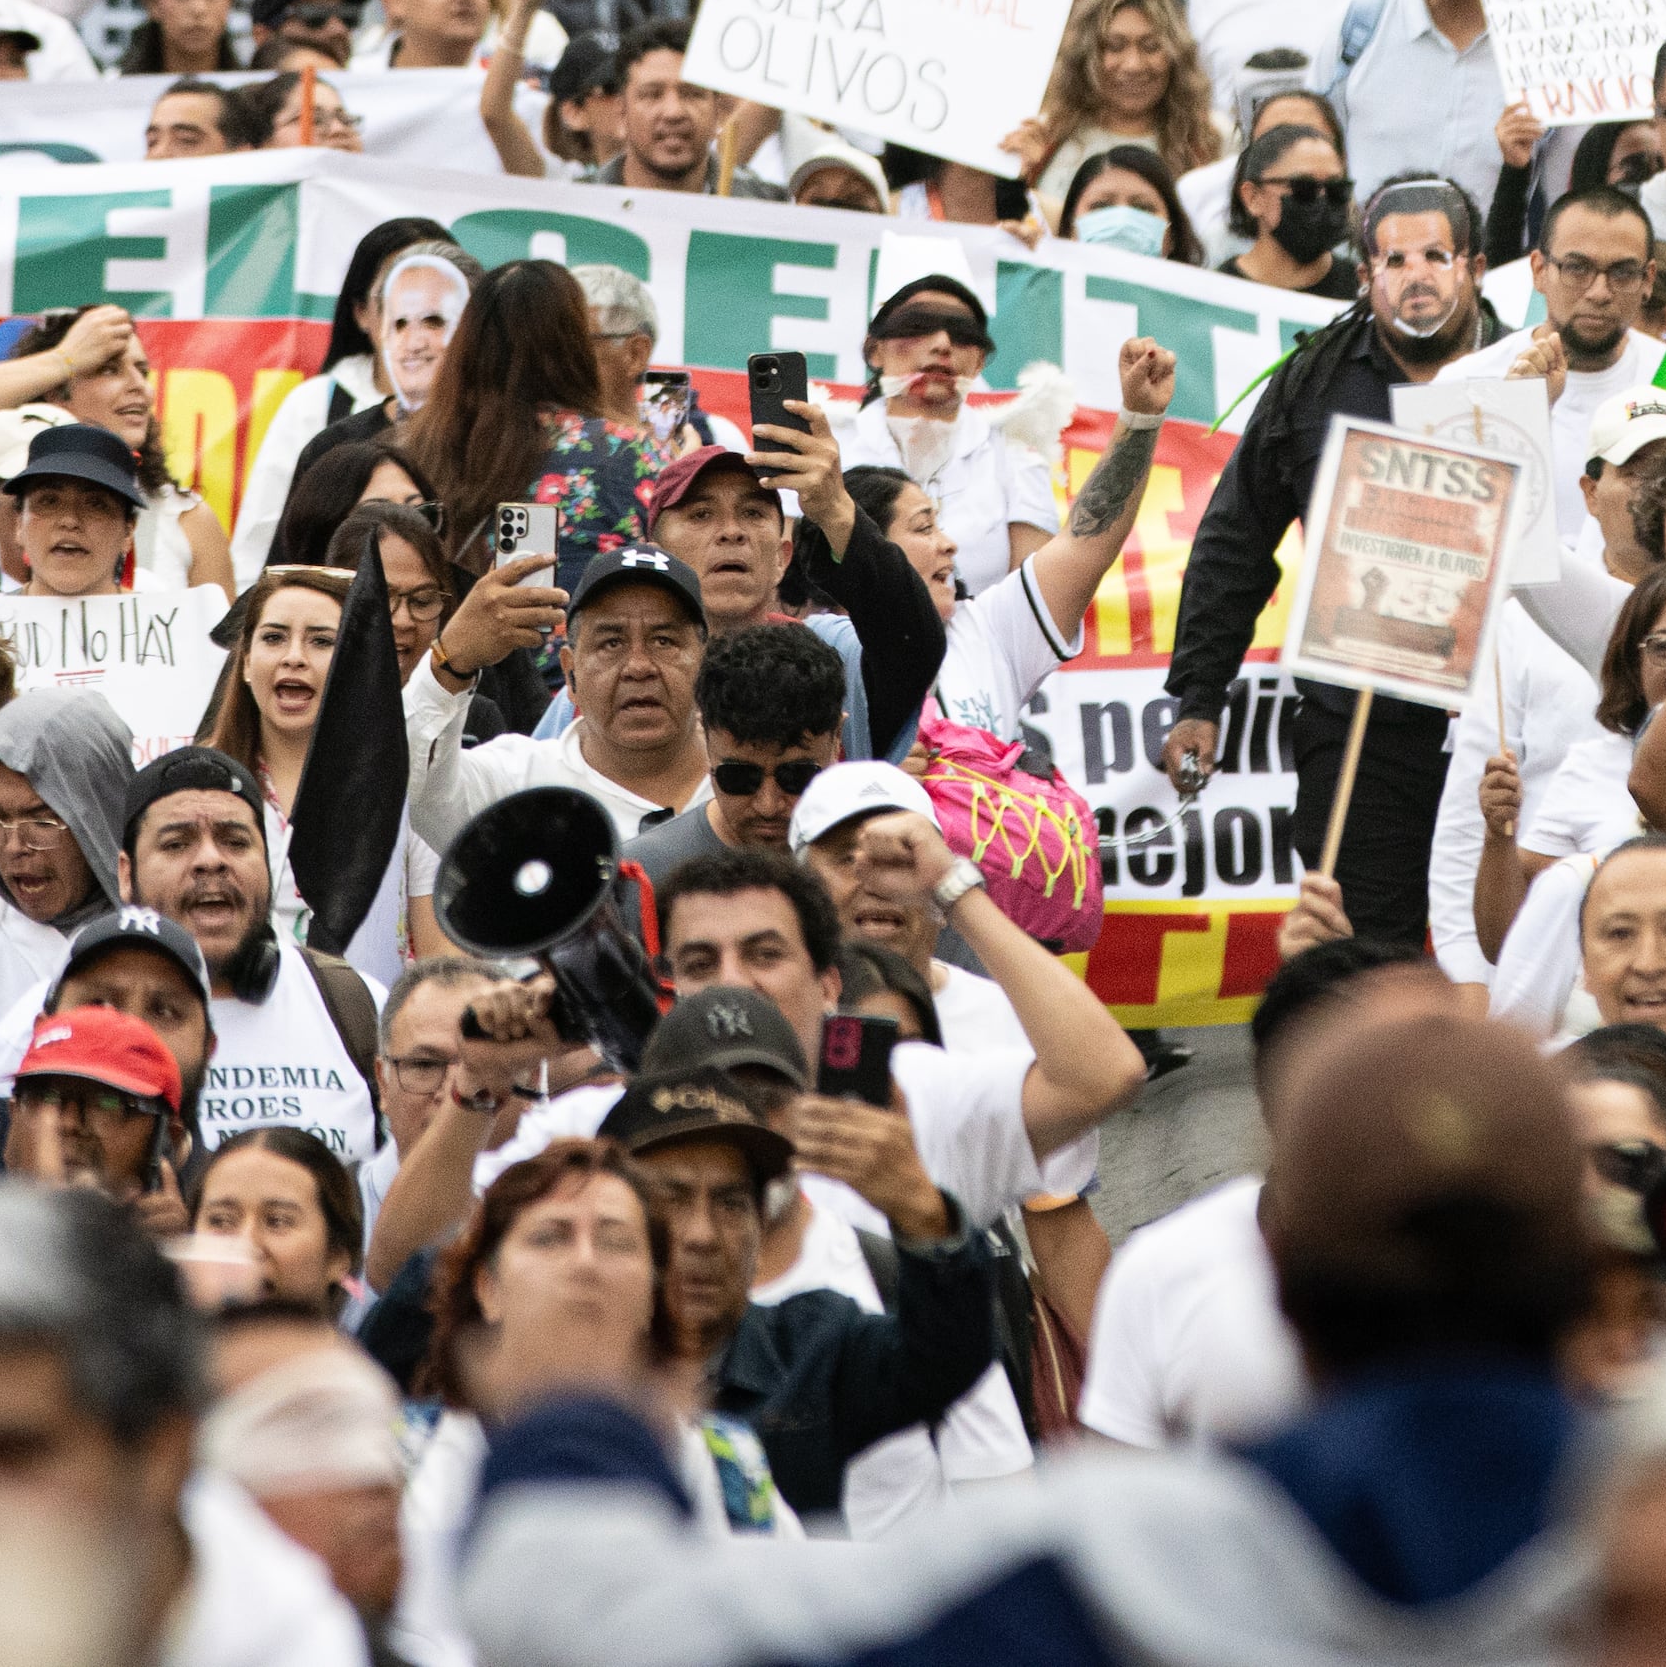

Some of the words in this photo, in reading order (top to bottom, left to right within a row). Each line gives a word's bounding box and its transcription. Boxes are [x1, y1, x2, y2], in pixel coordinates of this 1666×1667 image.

[717, 15, 950, 134] OLIVOS
[1357, 440, 1501, 505] SNTSS
[119, 596, 180, 669] HAY
[208, 1066, 347, 1094] NDEMIA
